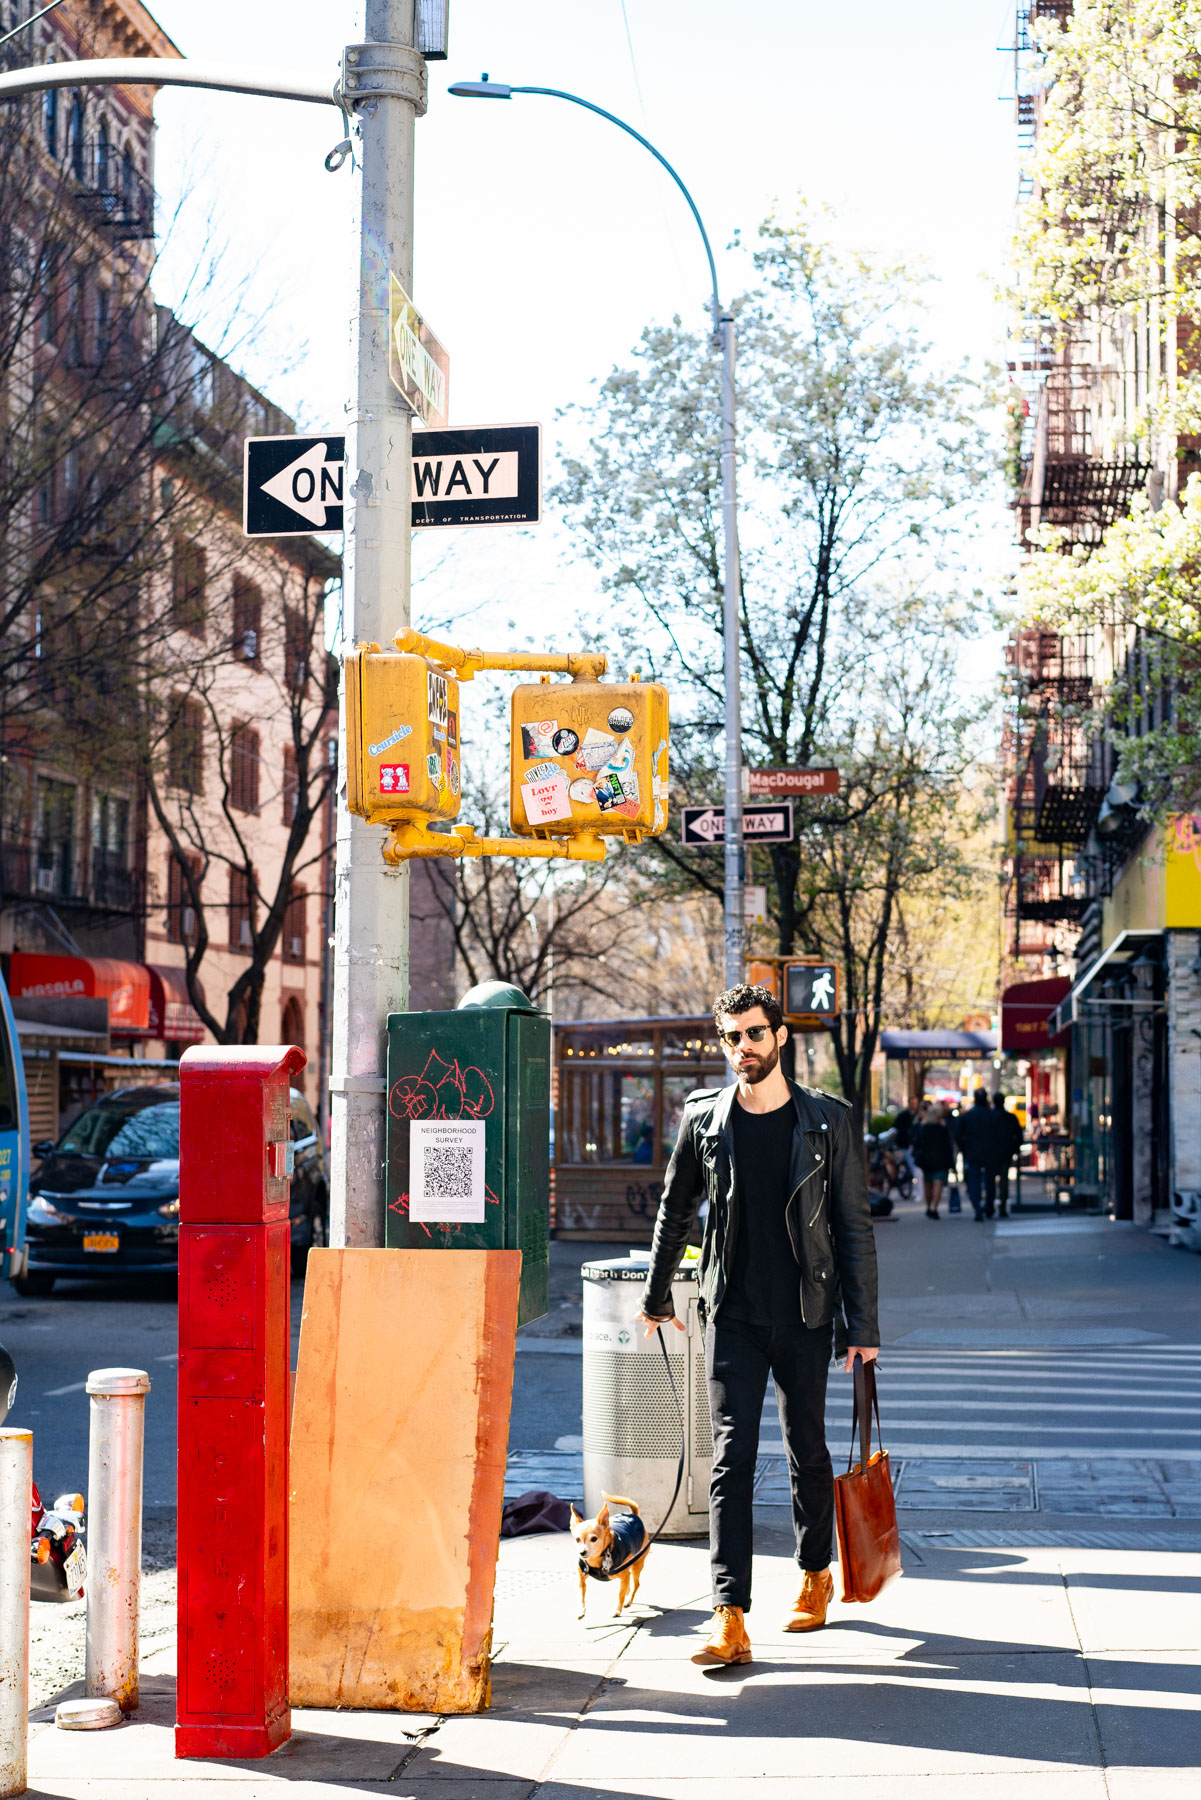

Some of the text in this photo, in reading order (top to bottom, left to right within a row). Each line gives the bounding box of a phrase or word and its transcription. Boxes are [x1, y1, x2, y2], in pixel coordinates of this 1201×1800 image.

[400, 320, 443, 404] ONE WAY
[291, 457, 500, 503] ON WAY
[459, 513, 527, 522] TRANSPORTATION
[368, 724, 413, 757] Coursicle
[750, 773, 824, 790] MacDougal
[541, 808, 558, 816] boy
[744, 816, 776, 830] WAY
[21, 979, 85, 998] MASALA
[621, 1270, 649, 1280] Don'
